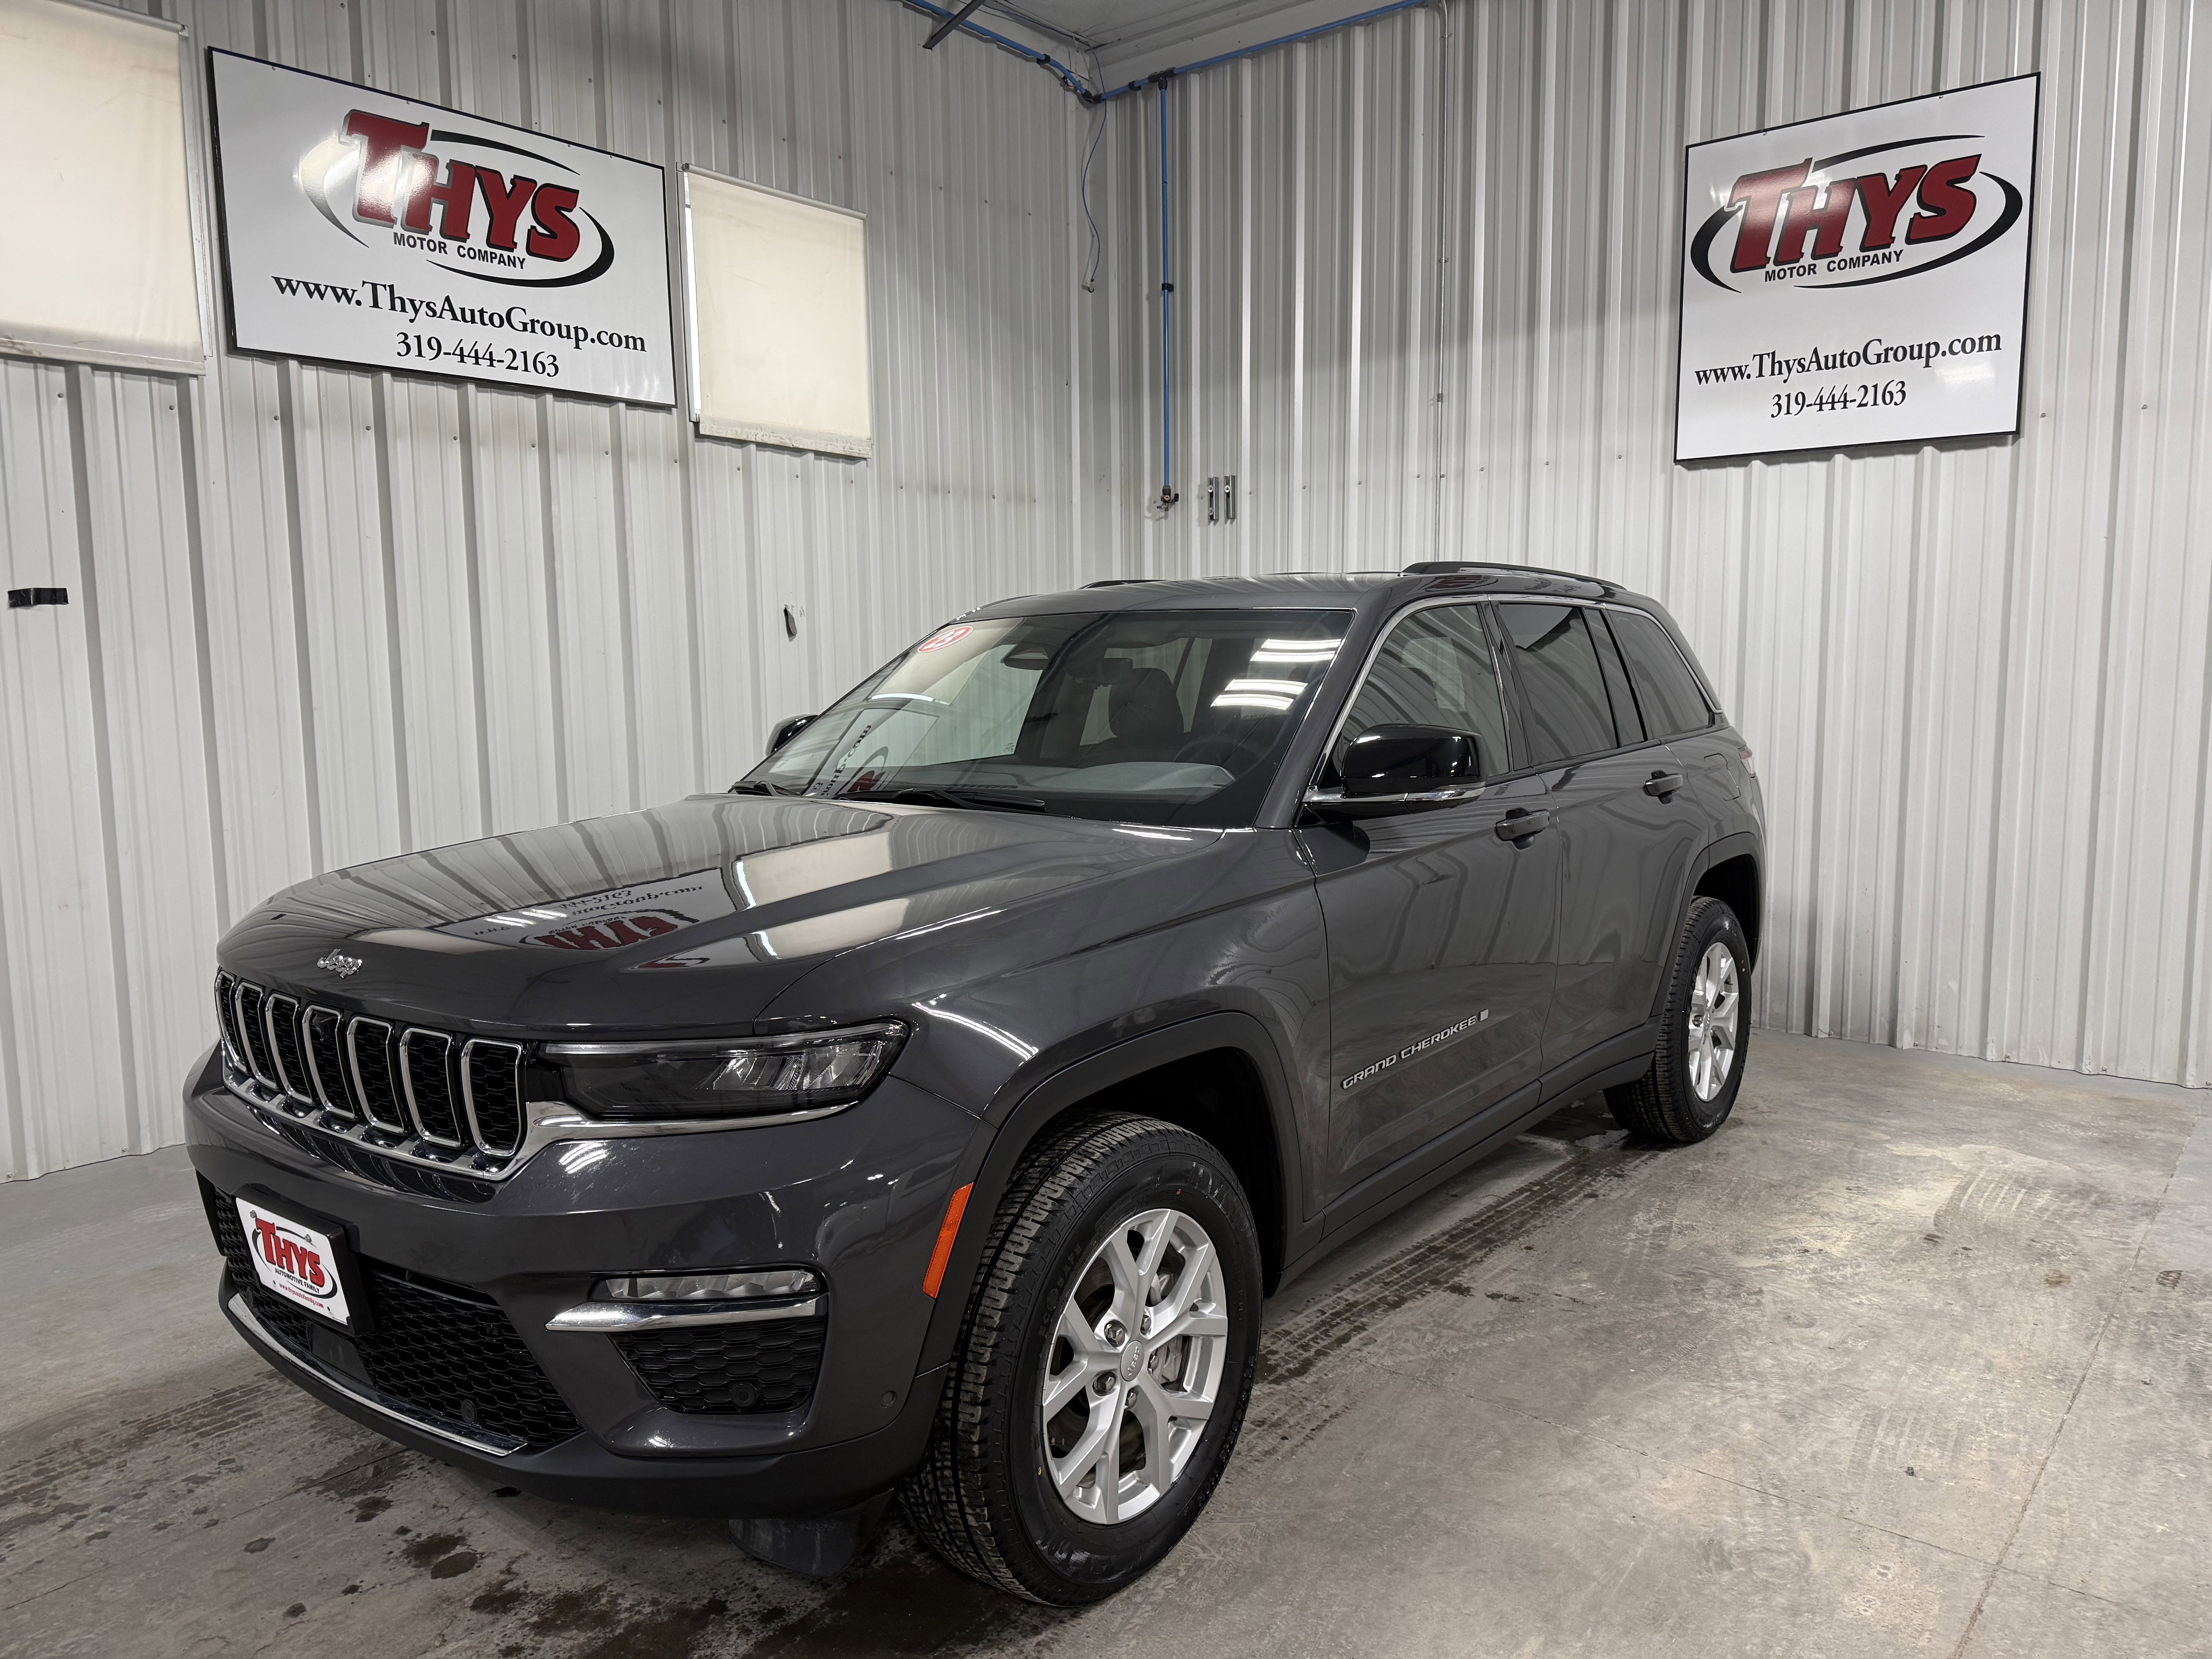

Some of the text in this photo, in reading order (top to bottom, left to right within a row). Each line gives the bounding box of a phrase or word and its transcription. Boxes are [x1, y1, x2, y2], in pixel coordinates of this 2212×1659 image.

[338, 109, 581, 263] THYS
[1724, 153, 1982, 273] THYS
[393, 232, 526, 270] MOTOR COMPANY
[1764, 249, 1903, 282] MOTOR COMPANY
[271, 275, 647, 352] www.ThysAutoGroup.com
[396, 332, 560, 377] 319-444-2163
[1694, 331, 2002, 385] www.ThysAutoGroup.com
[1770, 380, 1907, 418] 319-444-2163
[317, 948, 362, 979] Jeep
[1342, 1015, 1477, 1089] GRAND CHEROKEE
[255, 1218, 325, 1288] THYS
[275, 1267, 319, 1294] AUTOMOTIVE FAMILY
[1127, 1345, 1140, 1377] Jeep
